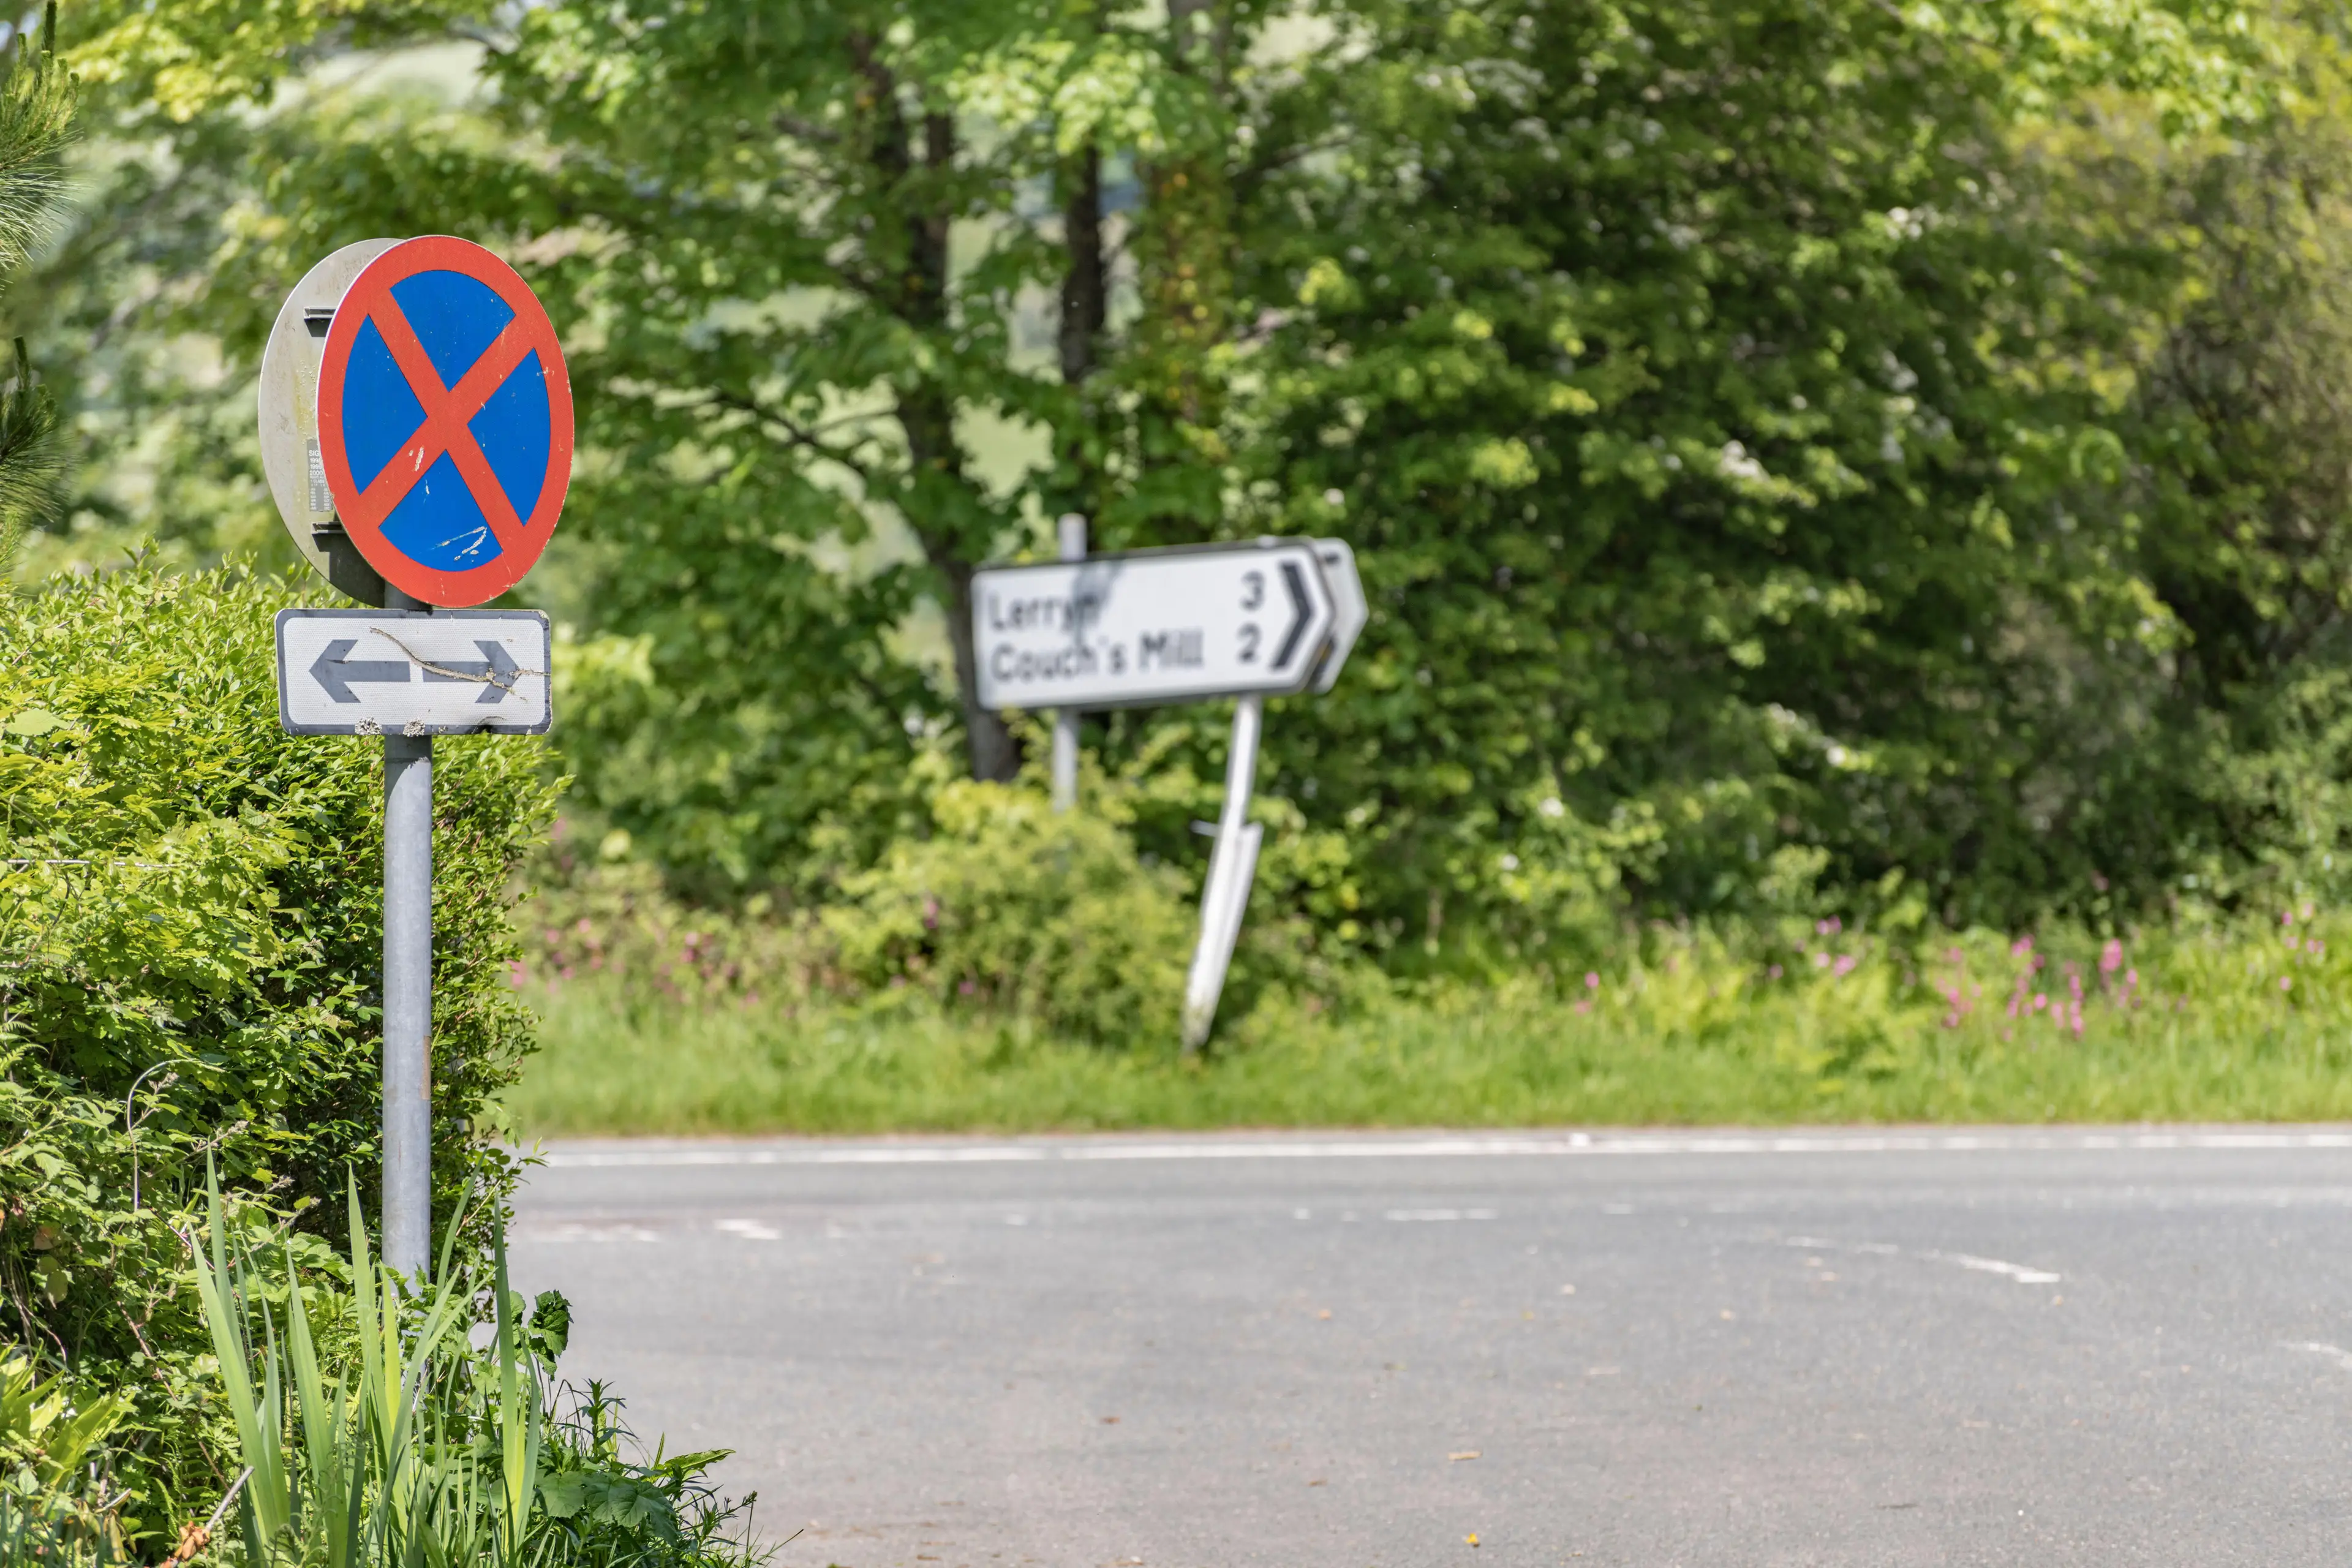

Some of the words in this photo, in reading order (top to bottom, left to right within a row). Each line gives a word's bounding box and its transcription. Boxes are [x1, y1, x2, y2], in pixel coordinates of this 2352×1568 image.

[1239, 569, 1265, 612] 3
[990, 633, 1128, 682] Couch's
[1139, 627, 1205, 672] Mill
[1235, 621, 1262, 665] 2
